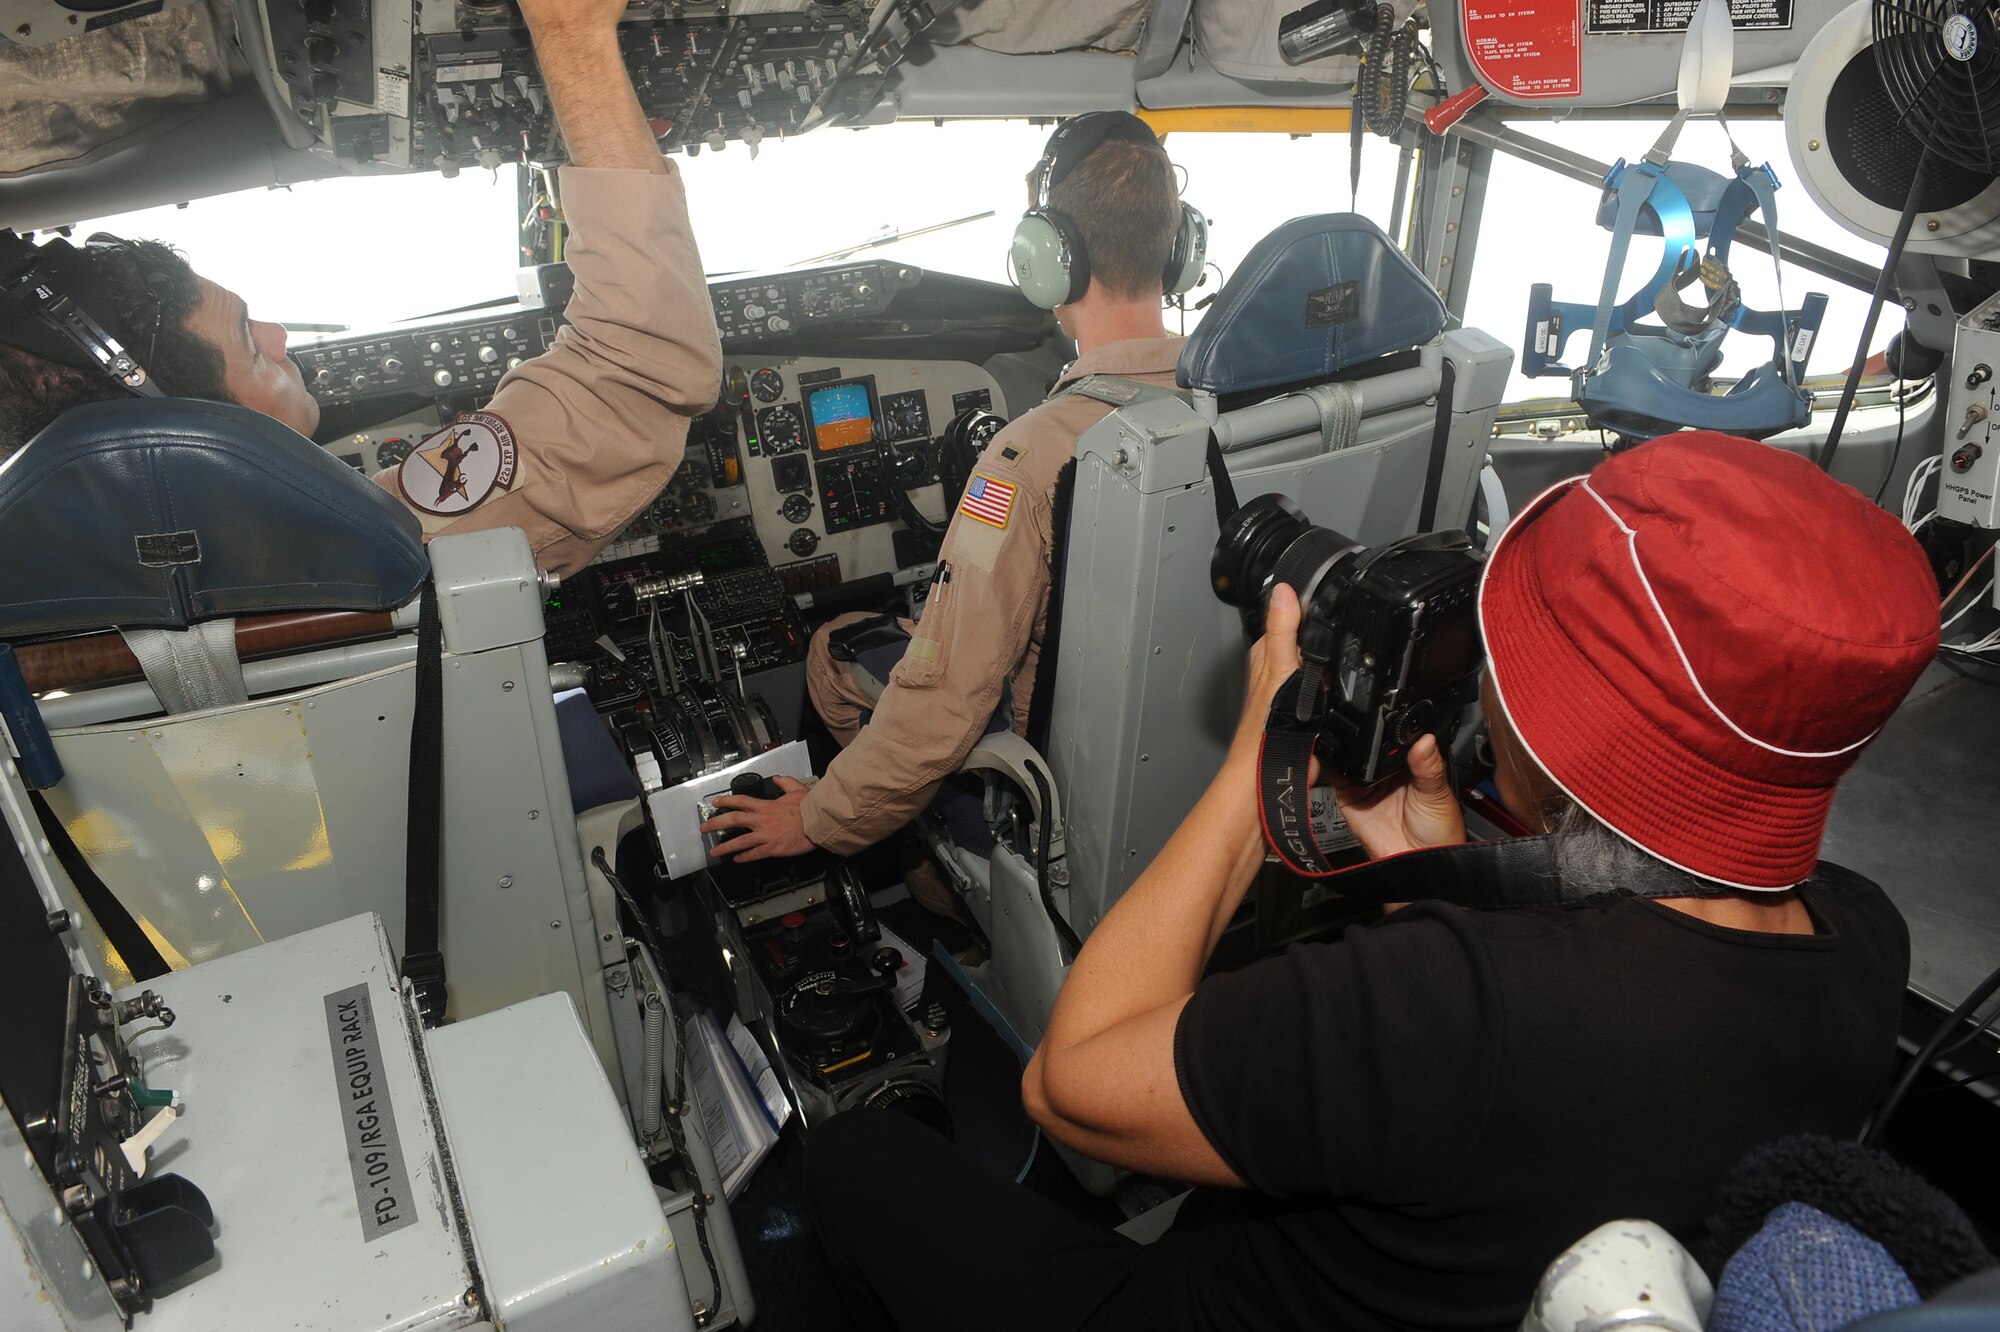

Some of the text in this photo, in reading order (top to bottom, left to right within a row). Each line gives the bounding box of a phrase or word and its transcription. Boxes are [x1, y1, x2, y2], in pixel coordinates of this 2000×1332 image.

[473, 415, 505, 435] REFUELING
[500, 433, 511, 447] AIR
[503, 449, 512, 465] EXP
[1945, 483, 1993, 500] HHGPS Power
[1958, 494, 1977, 504] Panel
[928, 1011, 946, 1019] RELEASE
[337, 999, 401, 1227] FD-109/RGA EQUIP RACK
